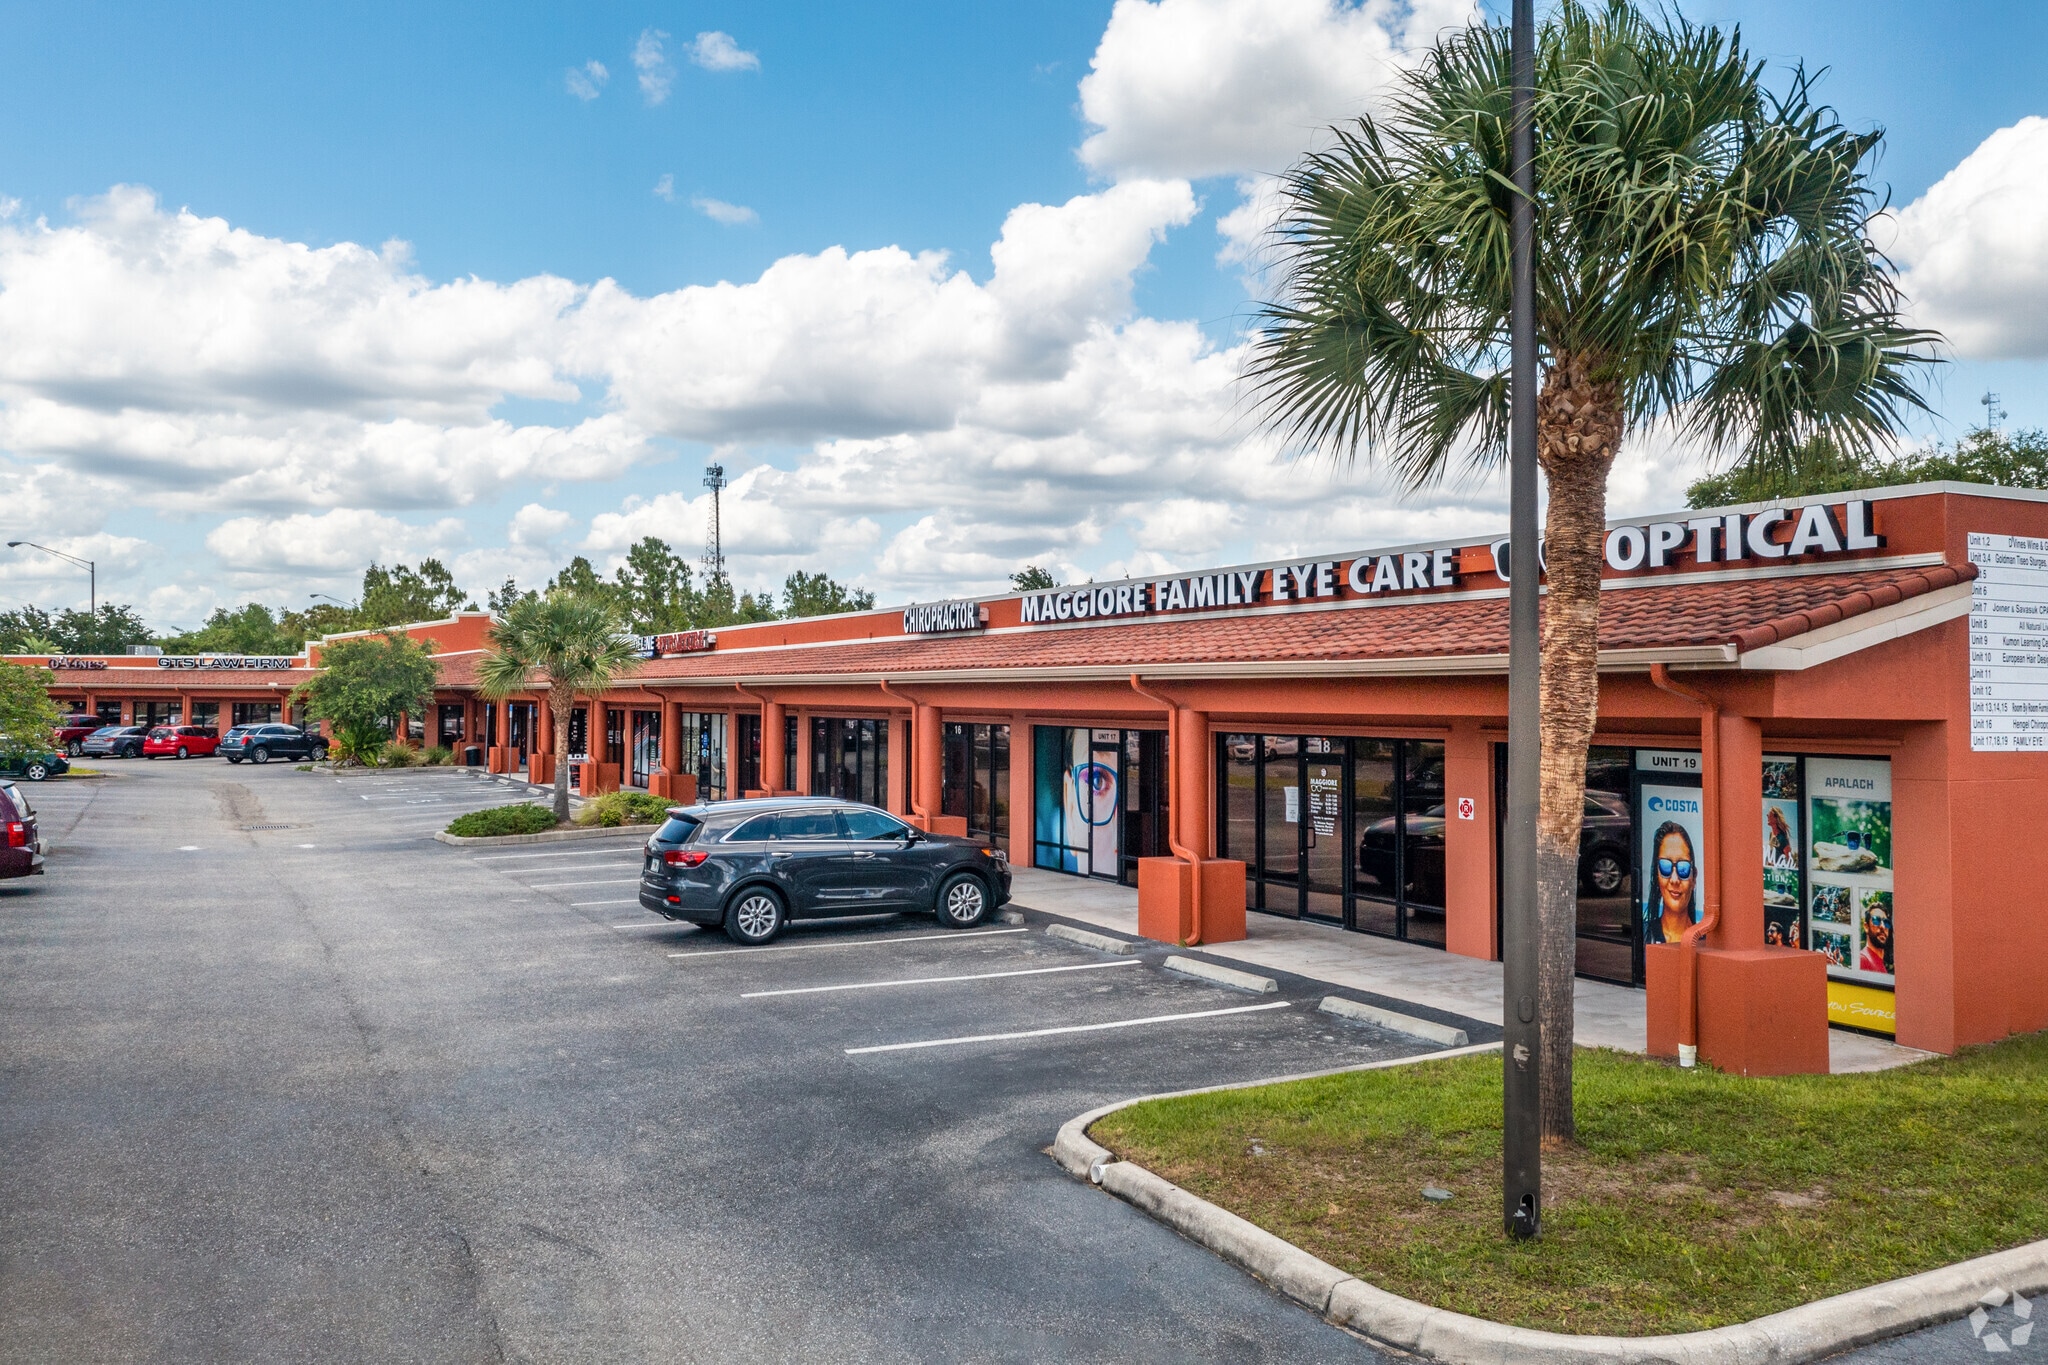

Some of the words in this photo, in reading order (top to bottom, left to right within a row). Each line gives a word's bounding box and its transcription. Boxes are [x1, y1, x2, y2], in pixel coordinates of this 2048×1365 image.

[1605, 501, 1878, 571] OPTICAL
[1969, 535, 1981, 545] Unit
[2027, 540, 2039, 550] Wine
[1970, 552, 1981, 562] Unit
[1983, 569, 1987, 579] 5
[1020, 583, 1146, 623] MAGGIORE
[1155, 570, 1259, 611] FAMILY
[1272, 561, 1334, 601] EYE
[1348, 548, 1453, 594] CARE
[1983, 586, 1987, 596] 6
[1983, 602, 1987, 612] 7
[903, 601, 975, 634] CHIROPRACTOR
[1971, 618, 1982, 628] Unit
[1984, 619, 1987, 629] 8
[1972, 635, 1983, 645] Unit
[1984, 635, 1988, 645] 9
[2003, 636, 2020, 646] Kumon
[2021, 637, 2041, 650] Learning
[158, 658, 195, 668] GTS
[199, 657, 240, 668] LAW
[244, 658, 288, 668] FIRM
[1972, 651, 1983, 661] Unit
[1985, 652, 1992, 662] 10
[2003, 652, 2025, 665] European
[2026, 654, 2036, 663] Hair
[1972, 668, 1983, 678] Unit
[1985, 669, 1992, 679] 11
[1972, 685, 1983, 695] Unit
[1985, 686, 1992, 696] 12
[1973, 702, 1984, 712] Unit
[954, 725, 962, 734] 16
[1973, 719, 1984, 729] Unit
[1986, 719, 1993, 729] 16
[2013, 719, 2030, 731] Hengel
[1318, 740, 1331, 753] 18
[1973, 736, 1984, 746] Unit
[2013, 736, 2032, 746] FAMILY
[2033, 737, 2043, 746] EYE
[1652, 756, 1680, 767] UNIT
[1683, 758, 1697, 768] 19
[1825, 777, 1874, 789] APALACH
[1665, 799, 1699, 813] COSTA
